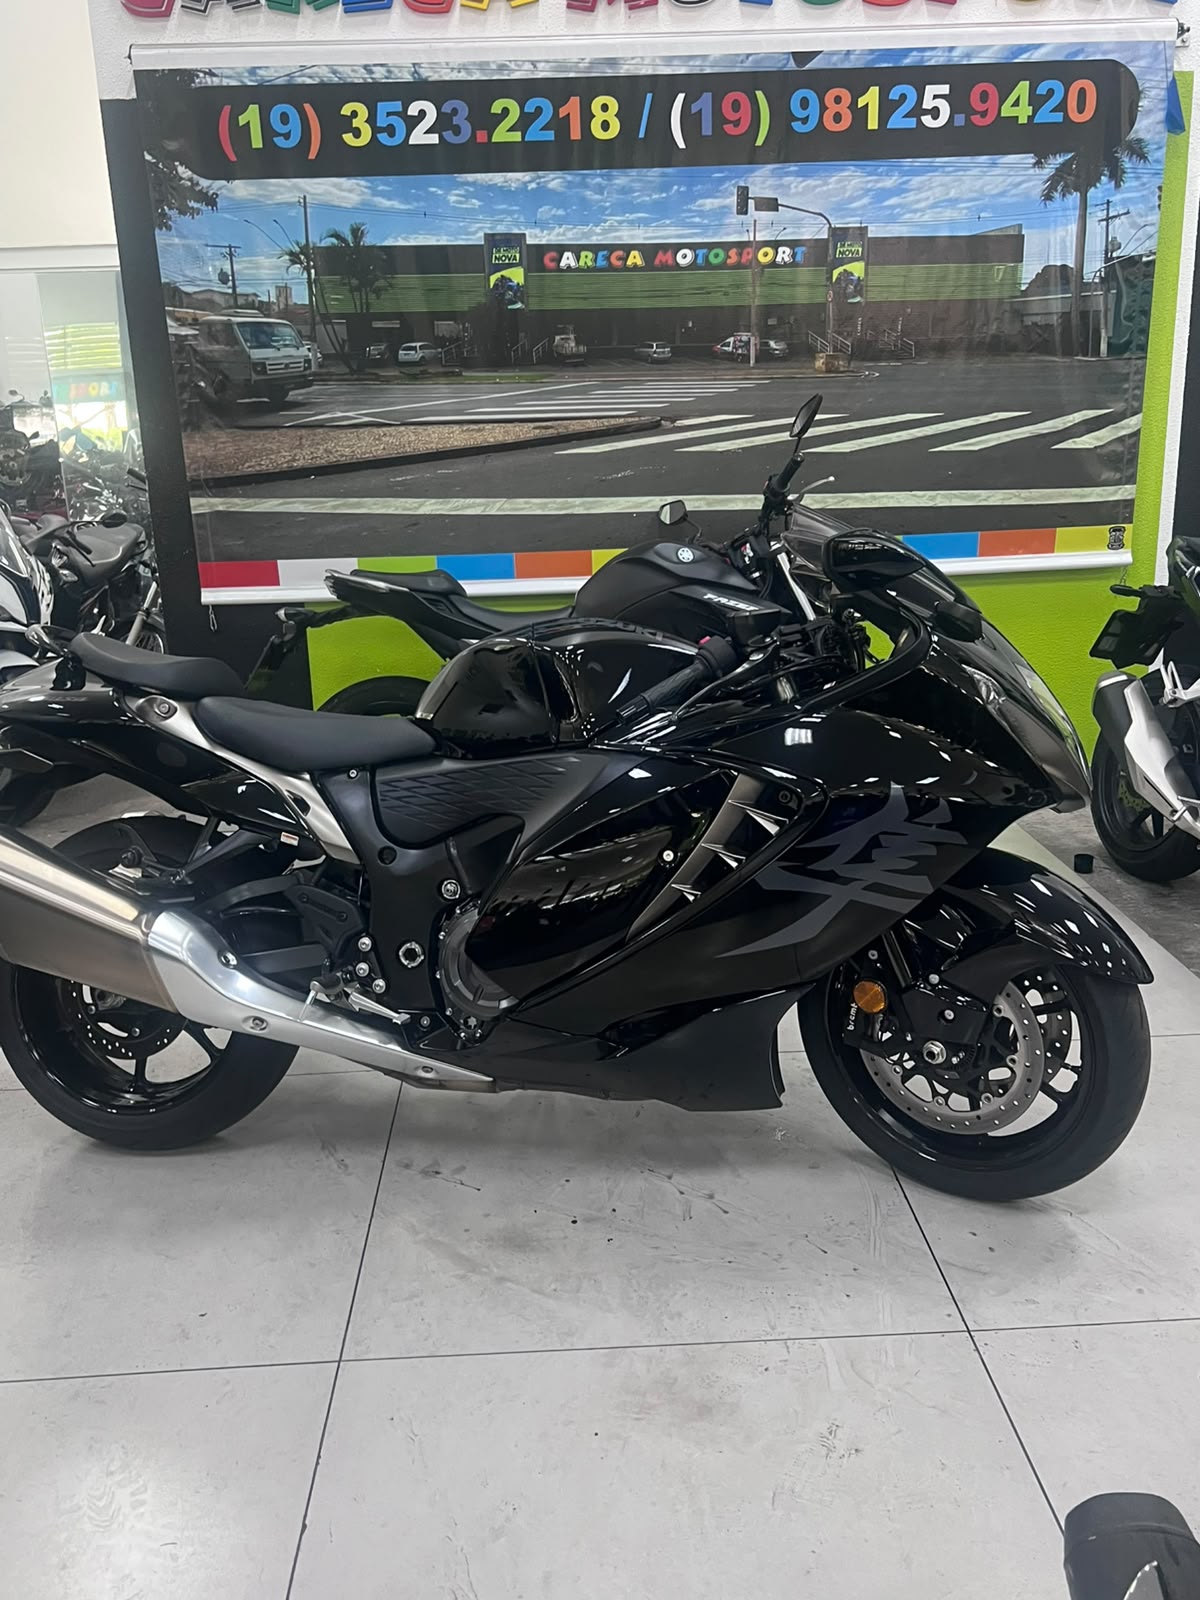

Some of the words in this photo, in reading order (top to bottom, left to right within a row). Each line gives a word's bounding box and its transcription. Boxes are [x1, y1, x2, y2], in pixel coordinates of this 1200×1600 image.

[218, 102, 321, 161] (19)
[340, 95, 620, 147] 3523.2218
[669, 91, 770, 149] (19)
[790, 79, 1097, 134] 98125.9420
[494, 254, 518, 262] NOVA
[543, 250, 645, 270] CARECA
[654, 247, 807, 267] MOTOSPORT
[837, 249, 860, 257] NOVA
